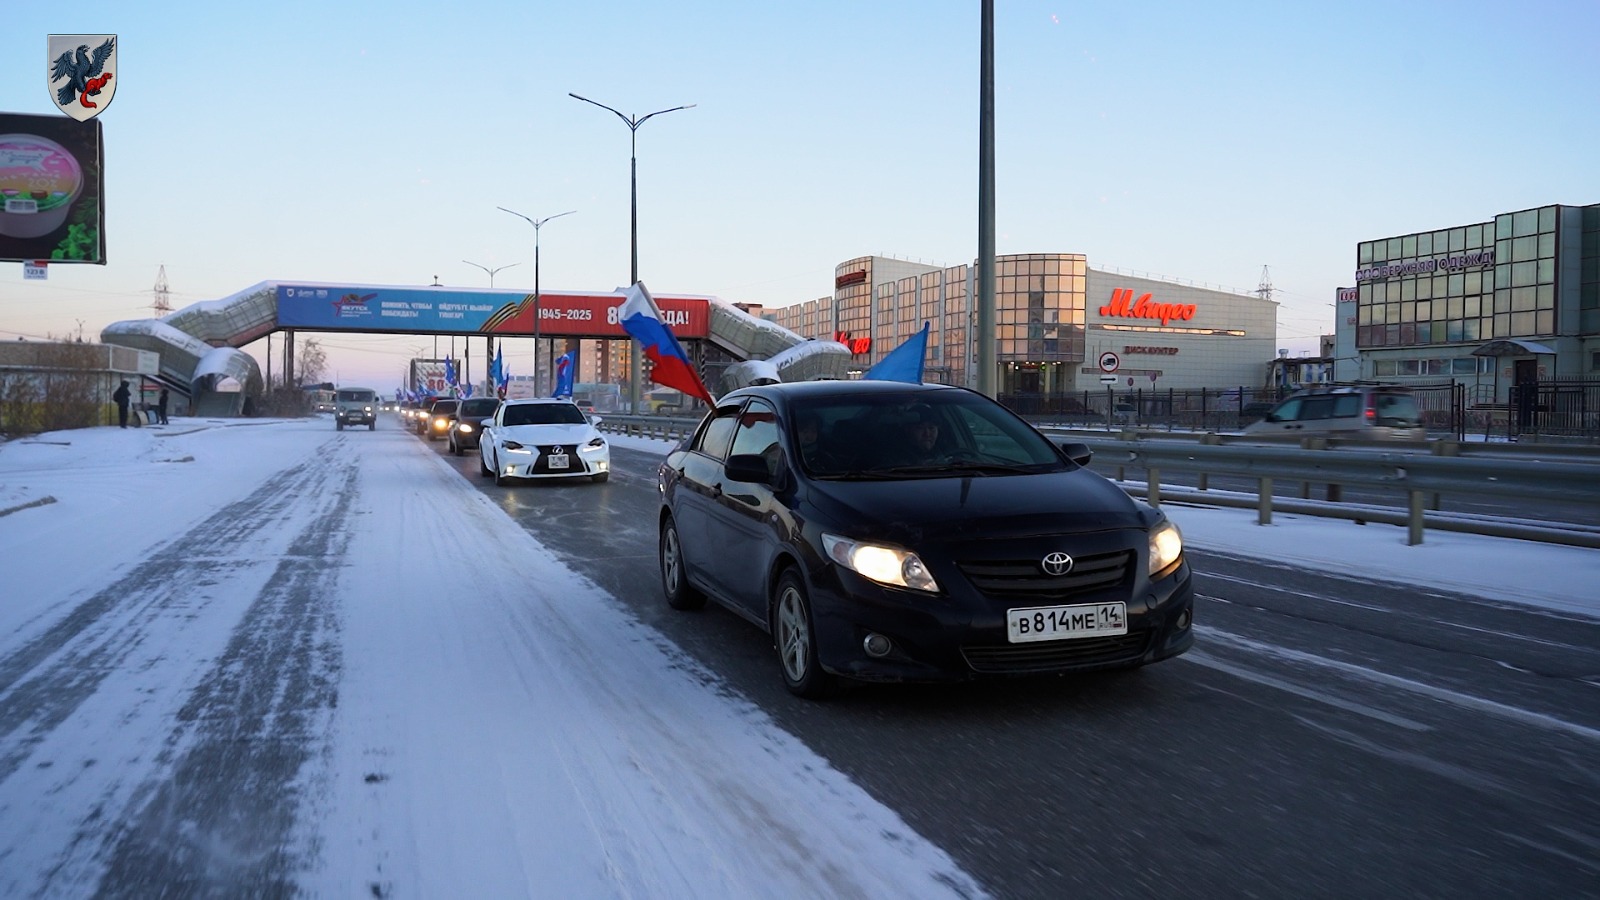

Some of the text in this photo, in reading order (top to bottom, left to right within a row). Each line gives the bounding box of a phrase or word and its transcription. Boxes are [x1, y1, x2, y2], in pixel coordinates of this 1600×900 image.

[1381, 260, 1436, 277] ВЕРХНЯЯ
[1438, 252, 1493, 270] ОДЕЖД
[1099, 288, 1197, 326] М.видео
[1019, 606, 1118, 634] В814МЕ 14
